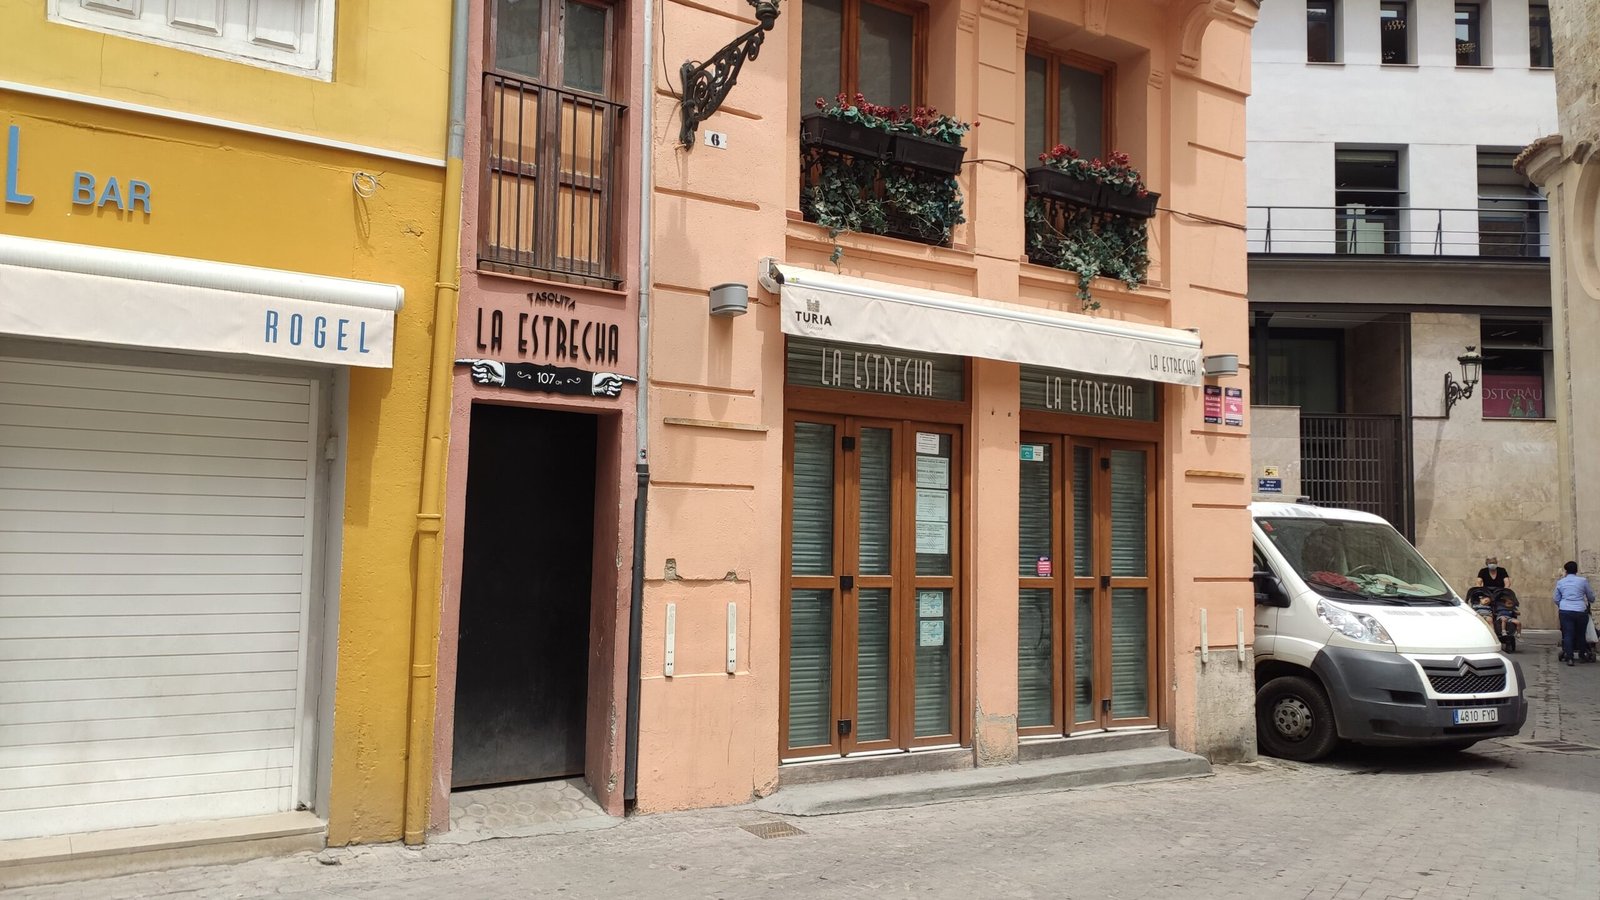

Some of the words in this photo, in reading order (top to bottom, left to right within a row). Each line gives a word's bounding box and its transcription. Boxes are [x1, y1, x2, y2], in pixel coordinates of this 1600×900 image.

[711, 133, 720, 147] 6
[72, 171, 152, 214] BAR
[526, 291, 576, 310] TASQUITA
[795, 310, 832, 326] TURIA
[265, 310, 370, 354] ROGEL
[476, 307, 503, 350] LA
[518, 312, 619, 363] ESTRECHA
[821, 347, 842, 387] LA
[854, 351, 933, 397] ESTRECHA
[1149, 353, 1159, 372] LA
[1162, 355, 1197, 377] ESTRECHA
[537, 371, 556, 385] 107
[1045, 375, 1062, 410] LA
[1070, 378, 1134, 418] ESTRECHA
[1460, 710, 1479, 722] 4810
[1482, 709, 1496, 721] FYD
